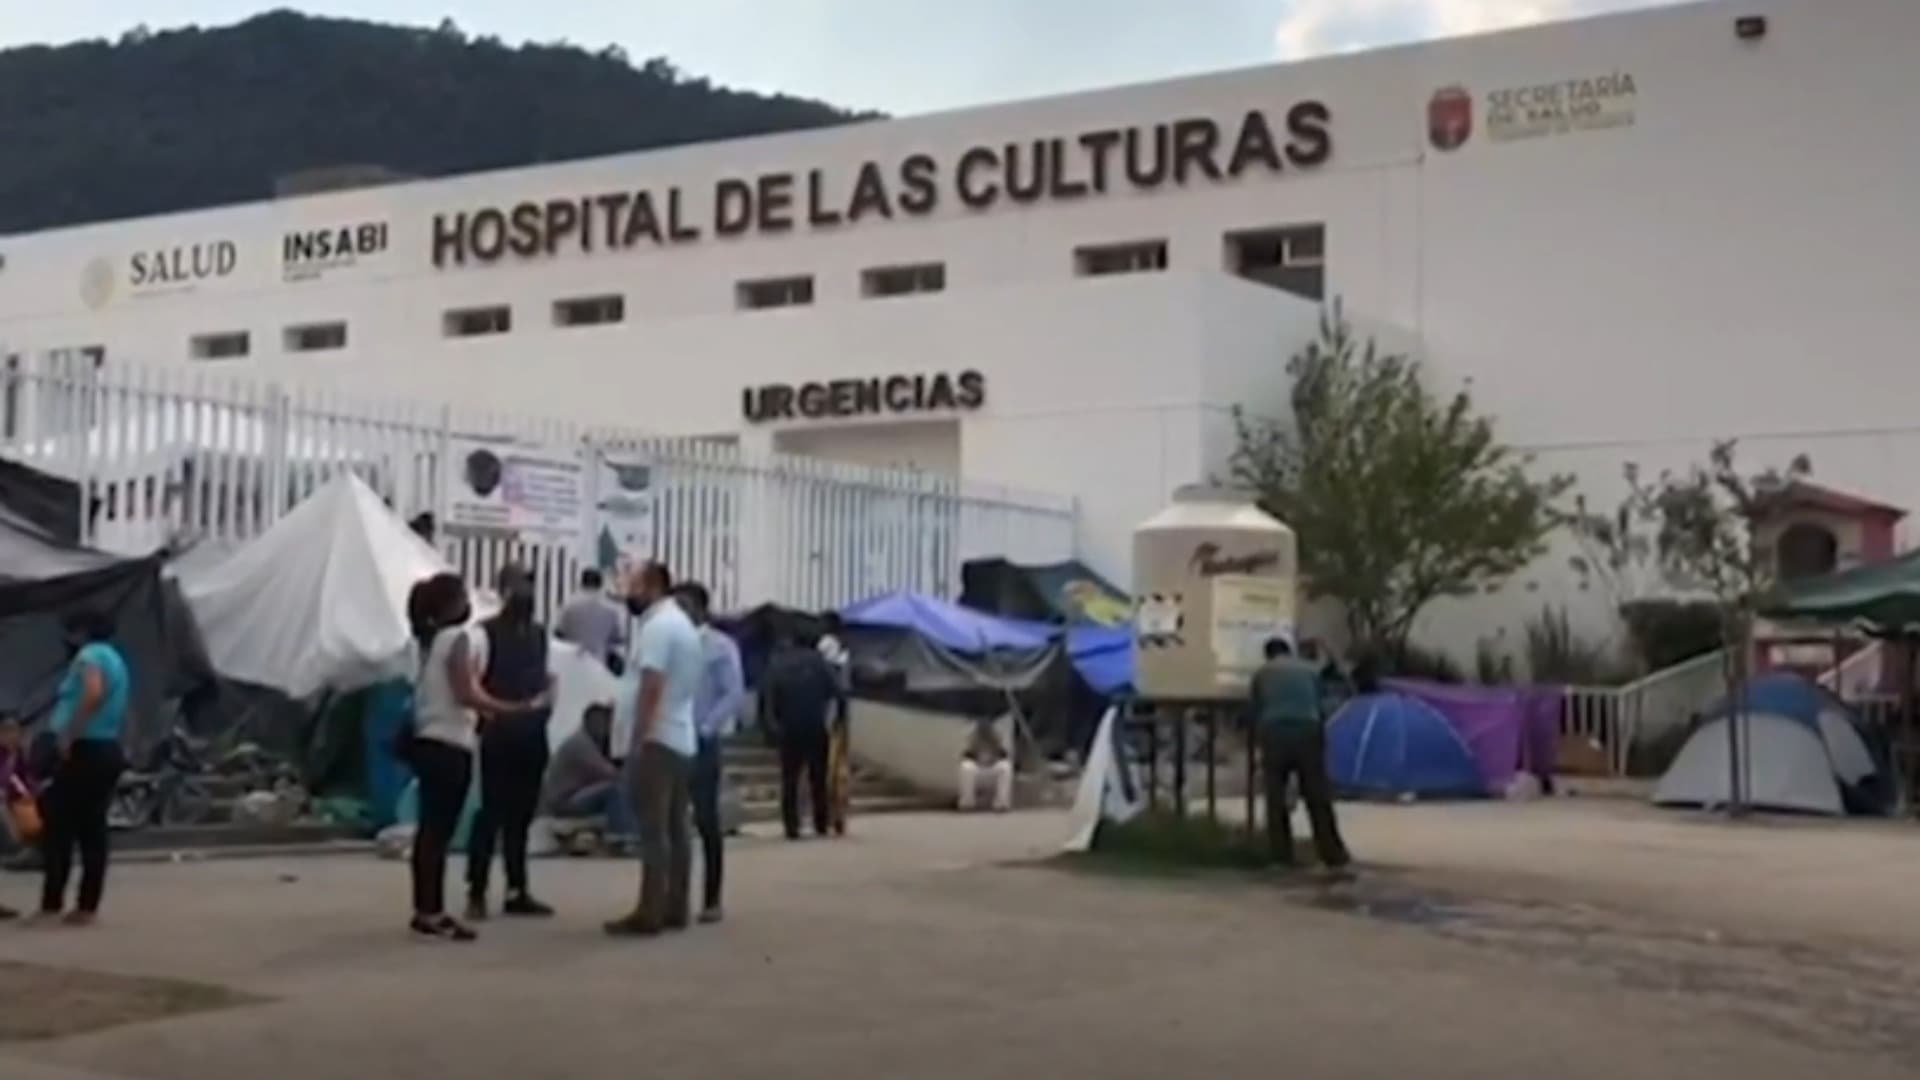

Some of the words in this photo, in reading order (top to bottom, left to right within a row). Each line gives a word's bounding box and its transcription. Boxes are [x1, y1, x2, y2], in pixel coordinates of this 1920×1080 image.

[431, 187, 699, 268] HOSPITAL
[715, 174, 793, 236] DE
[808, 153, 937, 227] LAS
[955, 100, 1331, 208] CULTURAS
[129, 240, 238, 286] SALUD
[282, 221, 389, 263] INSABI
[742, 368, 985, 424] URGENCIAS
